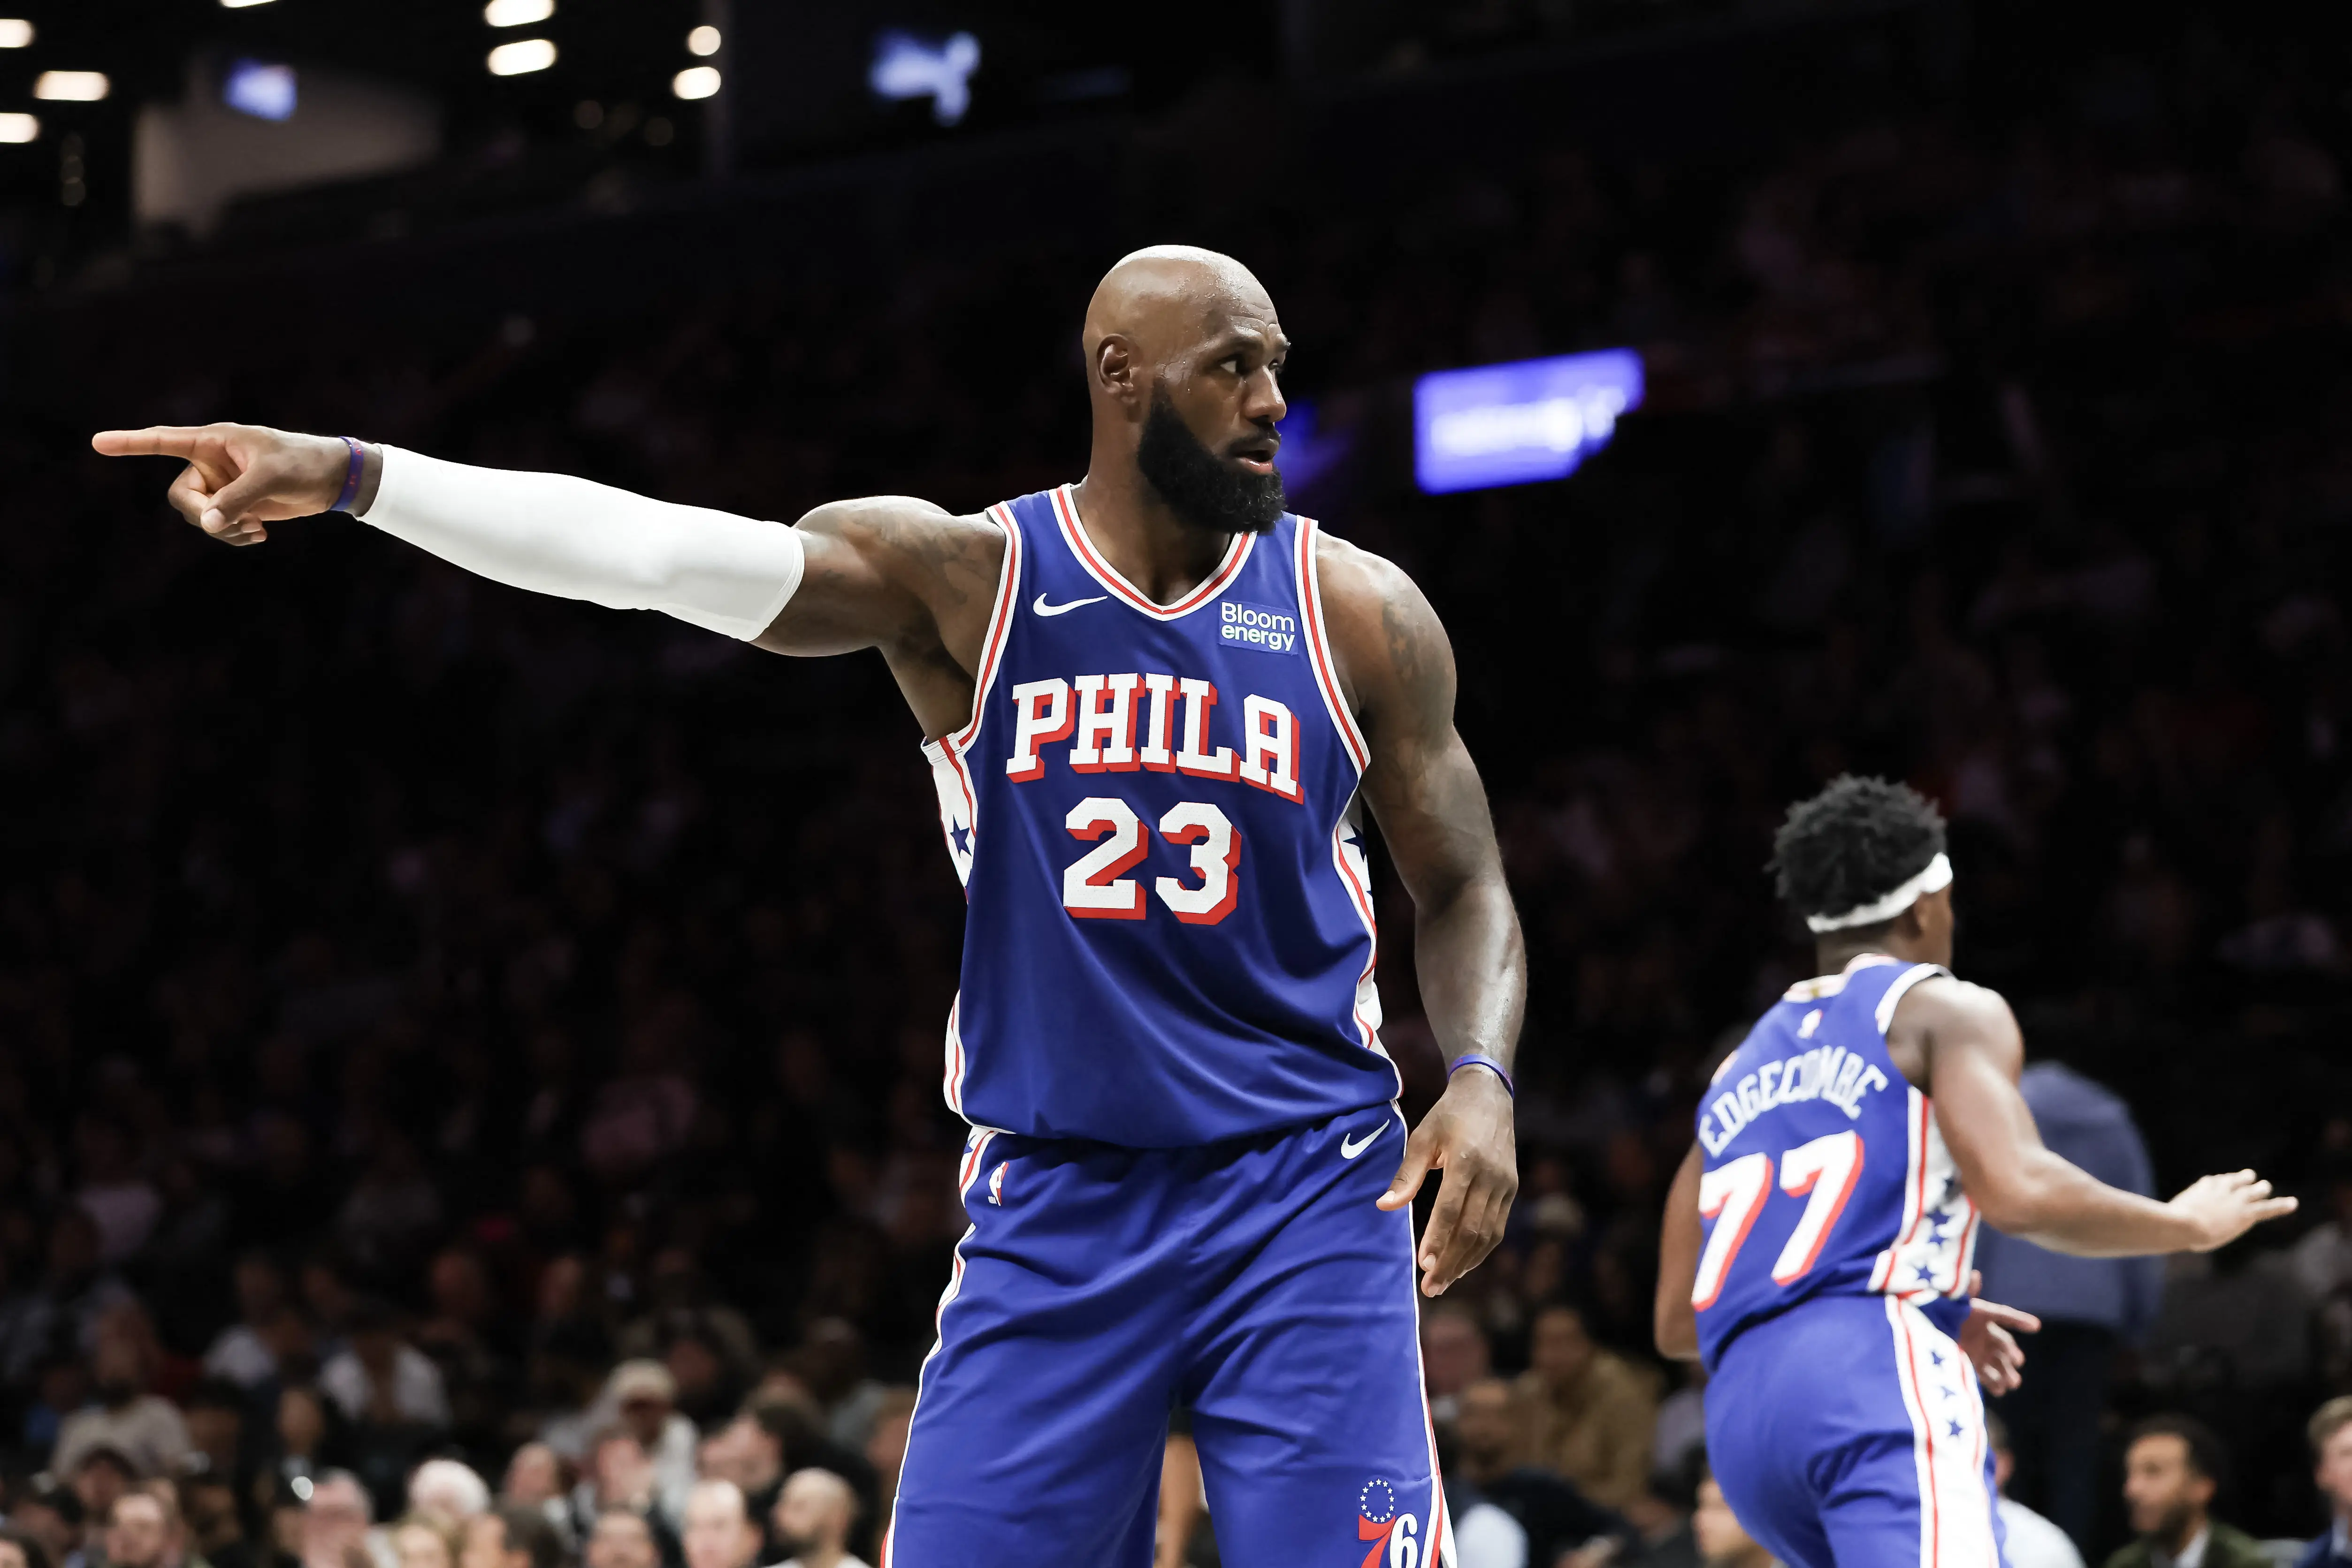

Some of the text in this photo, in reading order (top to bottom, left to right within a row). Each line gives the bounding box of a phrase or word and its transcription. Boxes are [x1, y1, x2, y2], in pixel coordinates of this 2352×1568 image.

[1221, 602, 1295, 632] Bloom
[1221, 624, 1296, 652] energy
[1006, 673, 1304, 805] PHILA
[1063, 796, 1242, 926] 23
[1691, 1129, 1864, 1312] 77
[1358, 1513, 1418, 1568] 76
